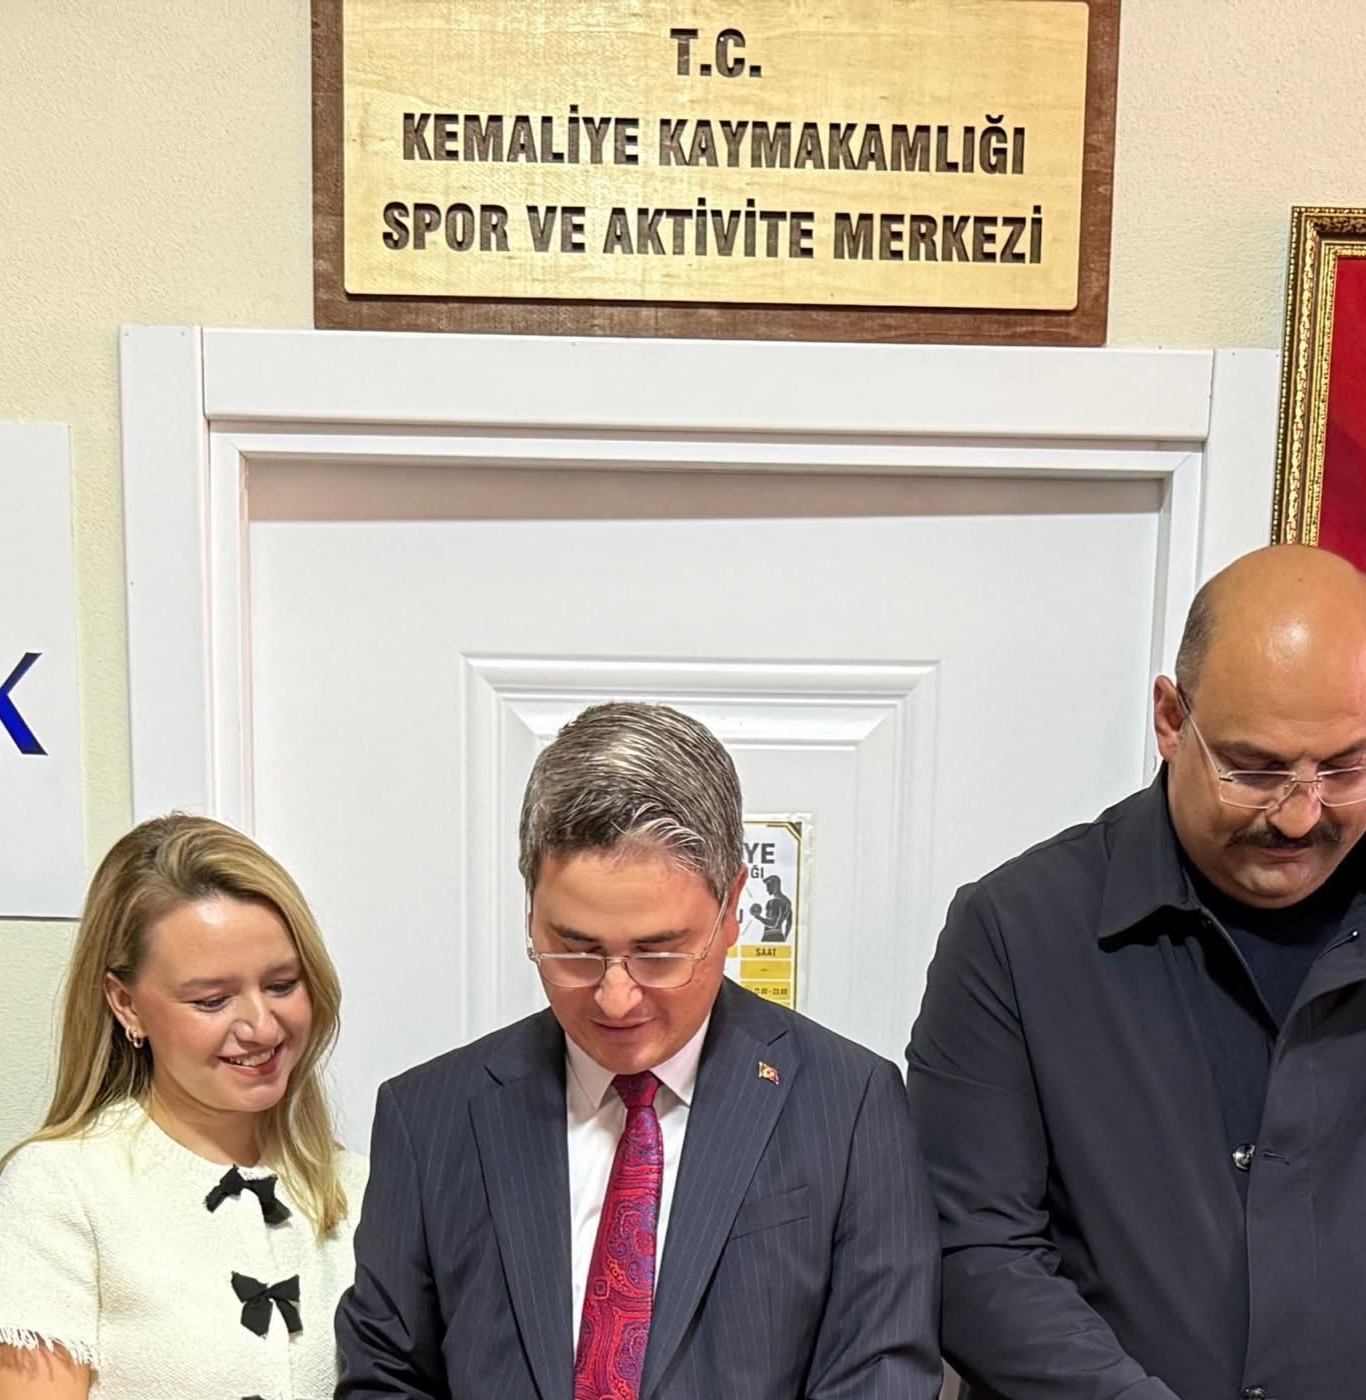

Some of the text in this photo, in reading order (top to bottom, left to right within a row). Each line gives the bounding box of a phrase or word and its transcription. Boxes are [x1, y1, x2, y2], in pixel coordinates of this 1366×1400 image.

[669, 28, 762, 78] T.C.
[402, 104, 1026, 174] KEMALİYE KAYMAKAMLIĞI
[382, 197, 1043, 265] SPOR VE AKTİVİTE MERKEZİ
[755, 948, 777, 957] SAAT
